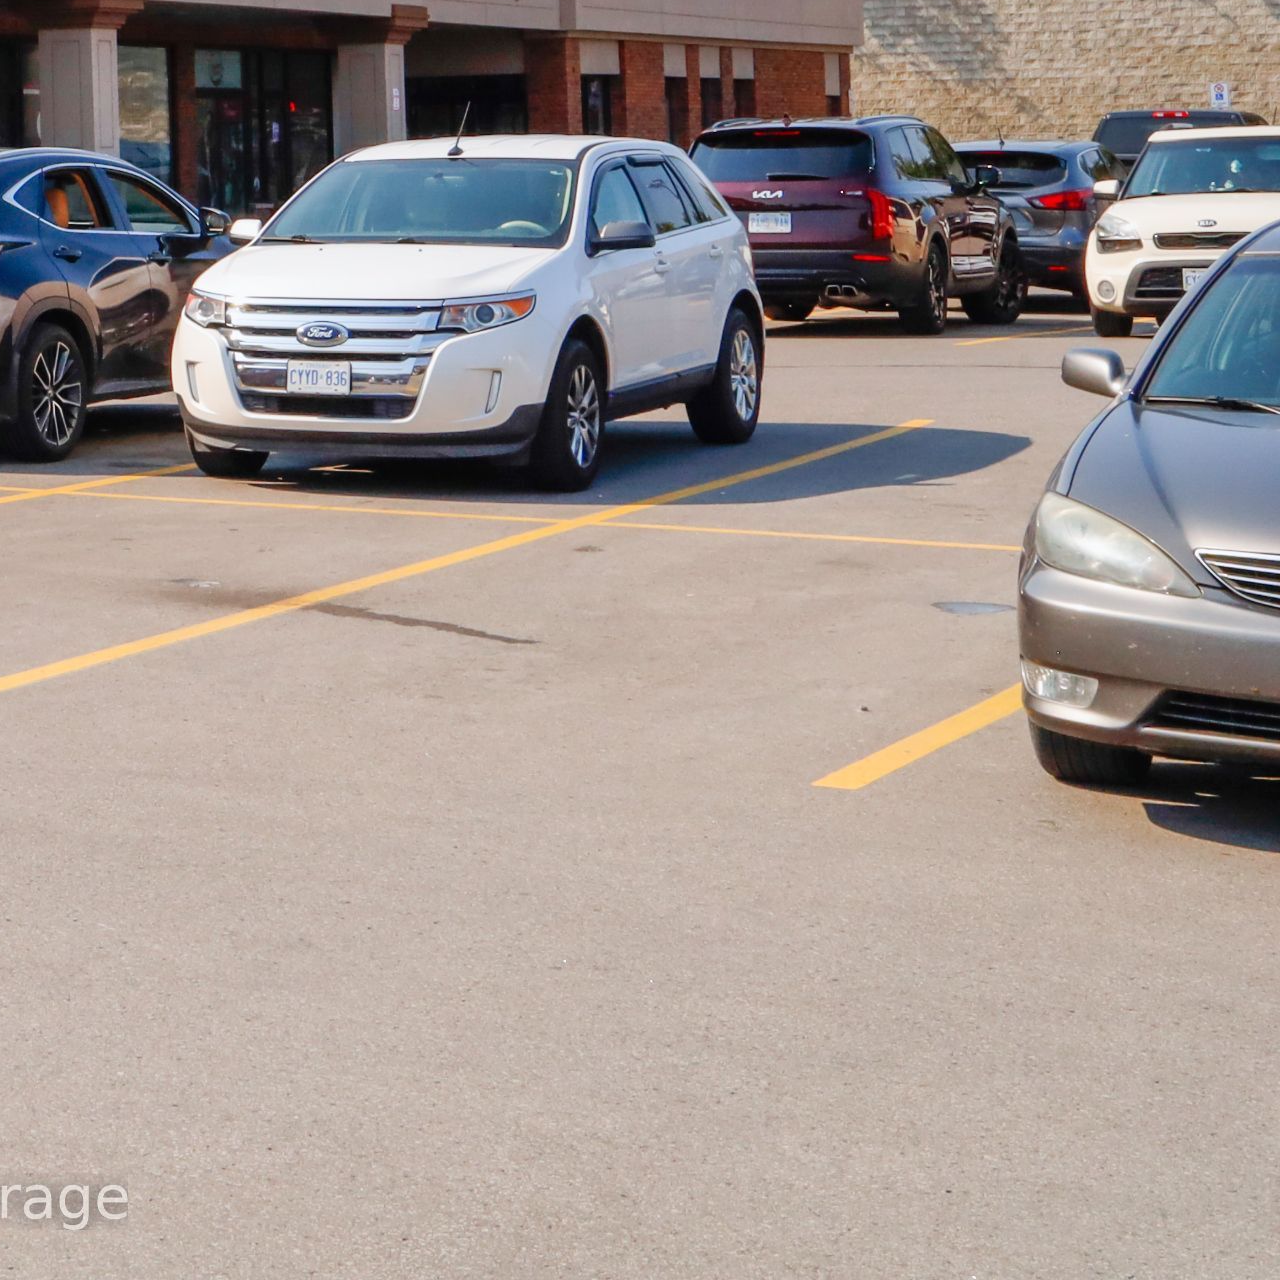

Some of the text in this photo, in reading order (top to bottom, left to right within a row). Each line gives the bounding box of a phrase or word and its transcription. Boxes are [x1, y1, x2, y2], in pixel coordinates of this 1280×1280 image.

[307, 326, 333, 338] Ford
[289, 369, 347, 386] CYYD 836
